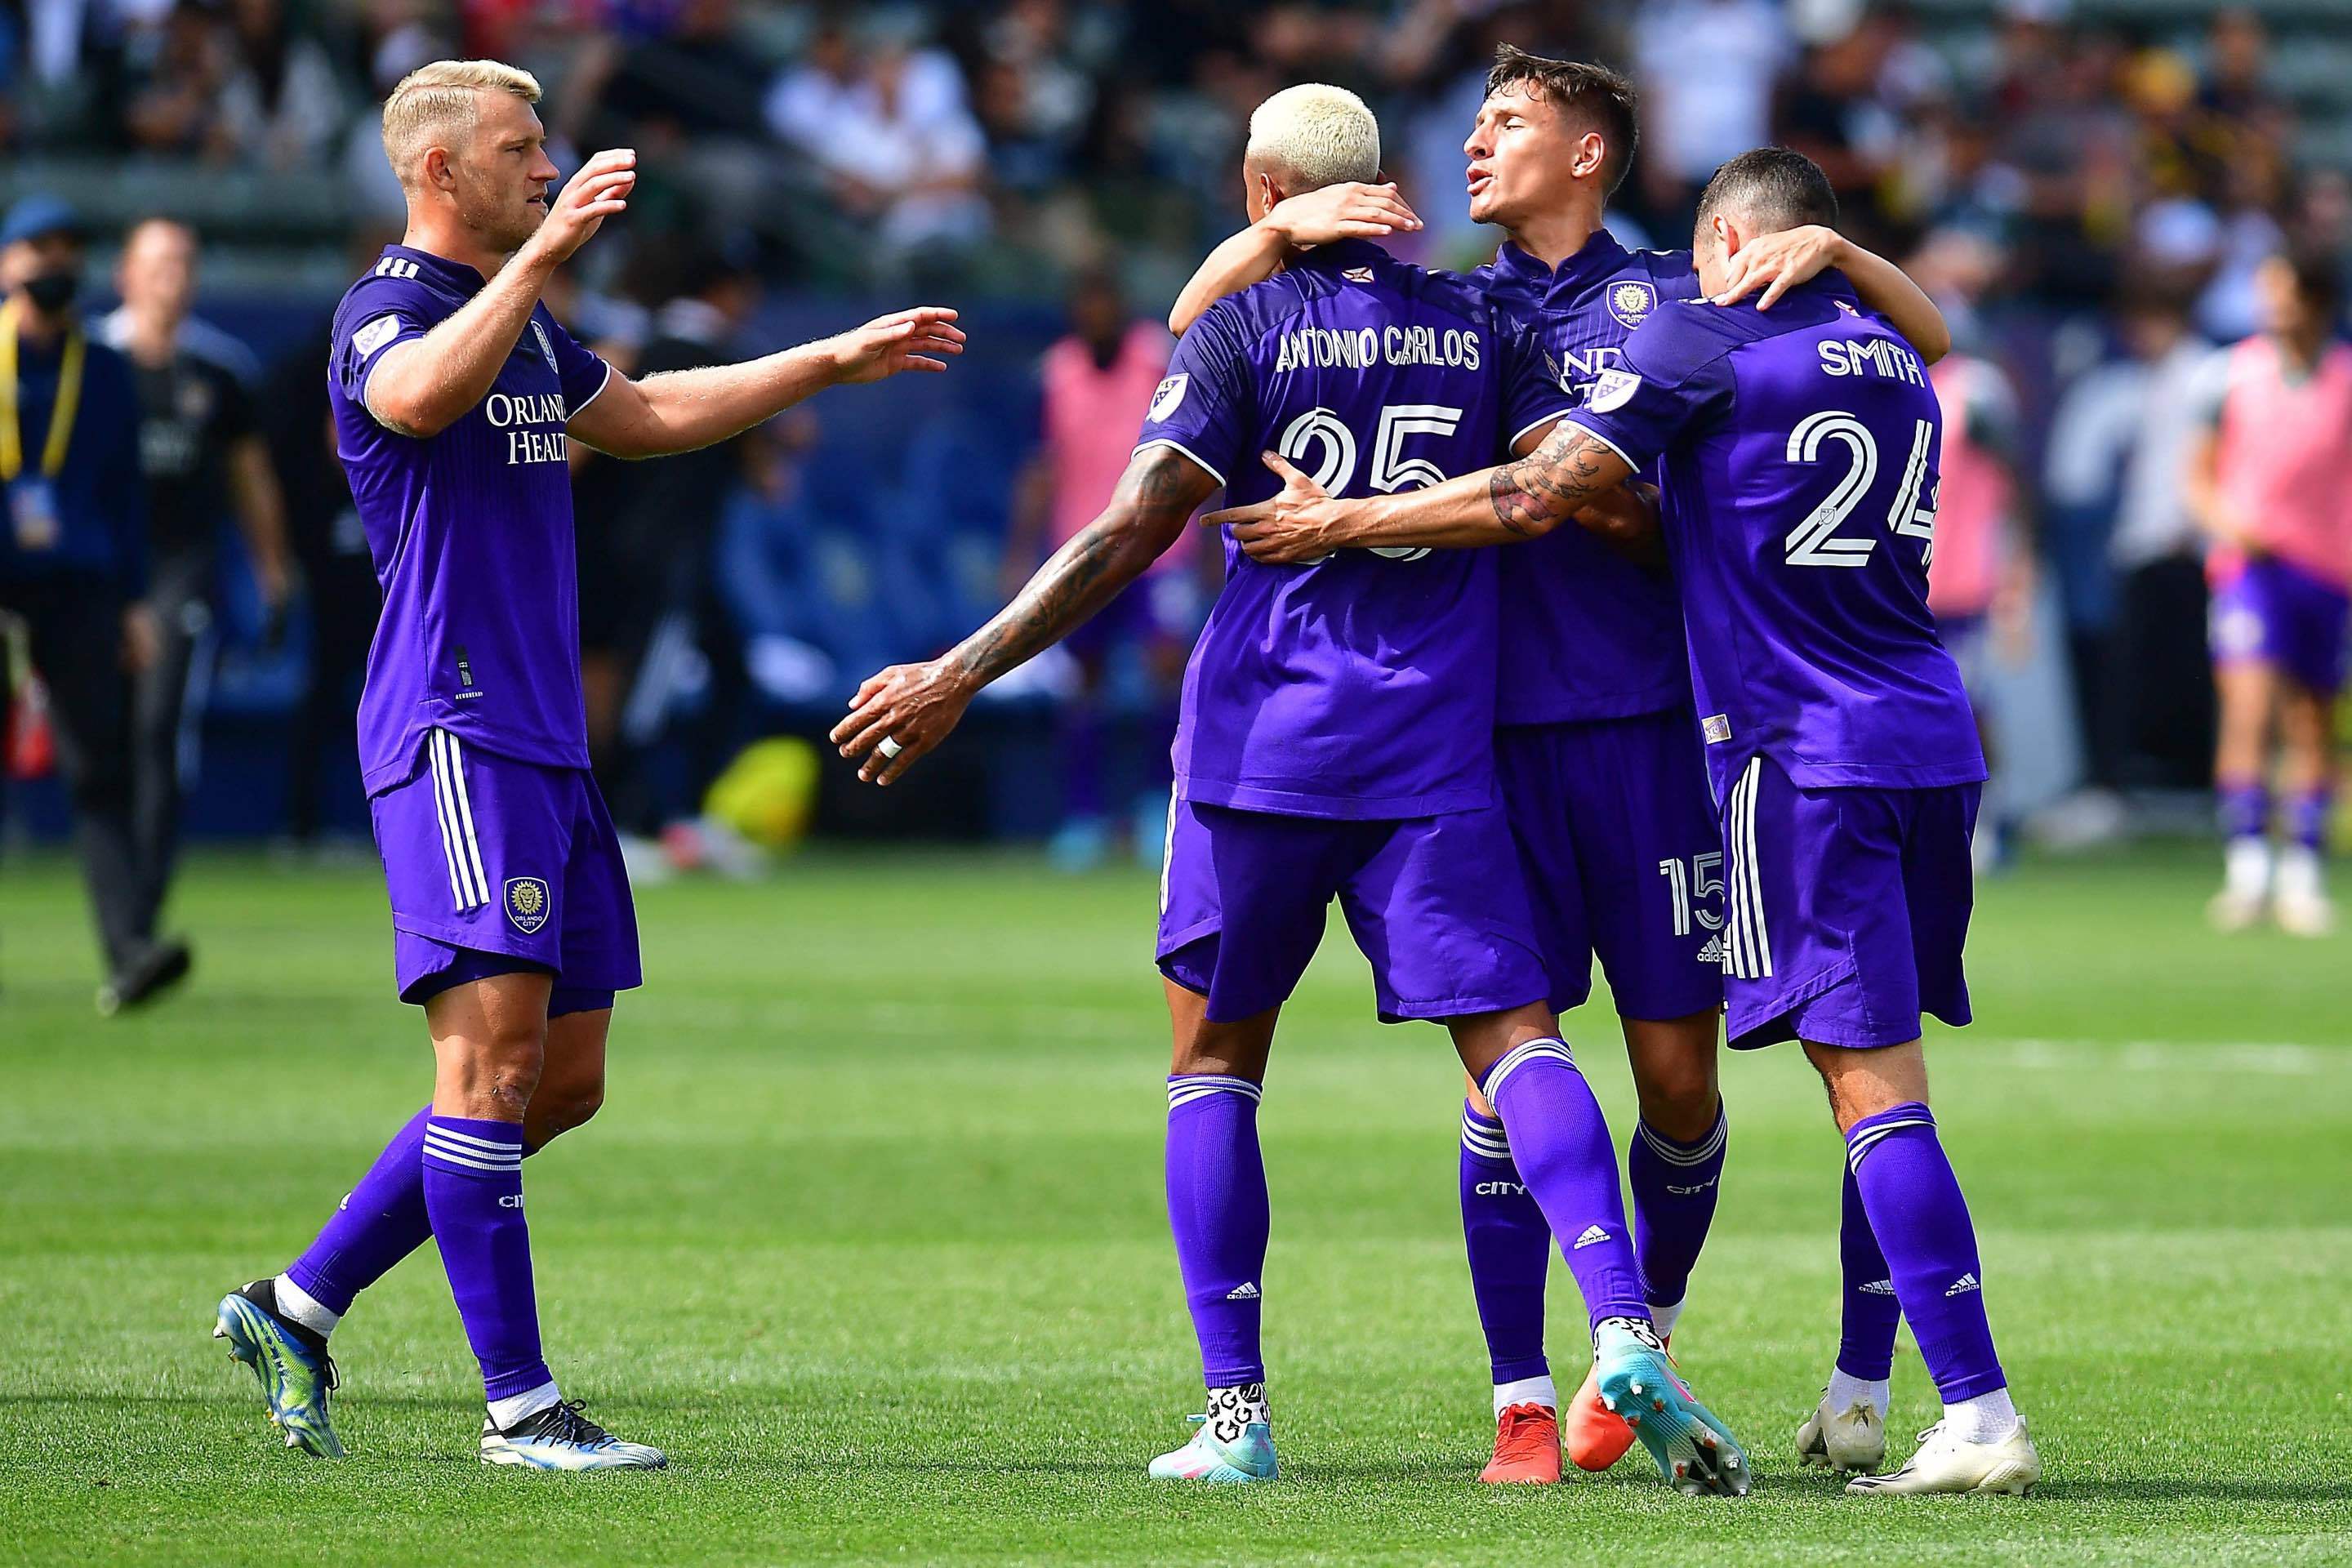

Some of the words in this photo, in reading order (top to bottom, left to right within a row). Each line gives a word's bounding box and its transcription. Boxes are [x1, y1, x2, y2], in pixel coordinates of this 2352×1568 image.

[1276, 326, 1379, 373] ANTONIO
[1383, 325, 1480, 371] CARLOS
[1817, 339, 1926, 388] SMITH
[1785, 410, 1940, 567] 24
[1659, 851, 1725, 936] 15
[1476, 1181, 1526, 1195] CITY
[1667, 1174, 1717, 1195] CITY
[1574, 1234, 1610, 1250] adidas
[1859, 1285, 1895, 1295] adidas
[1945, 1283, 1980, 1297] adidas
